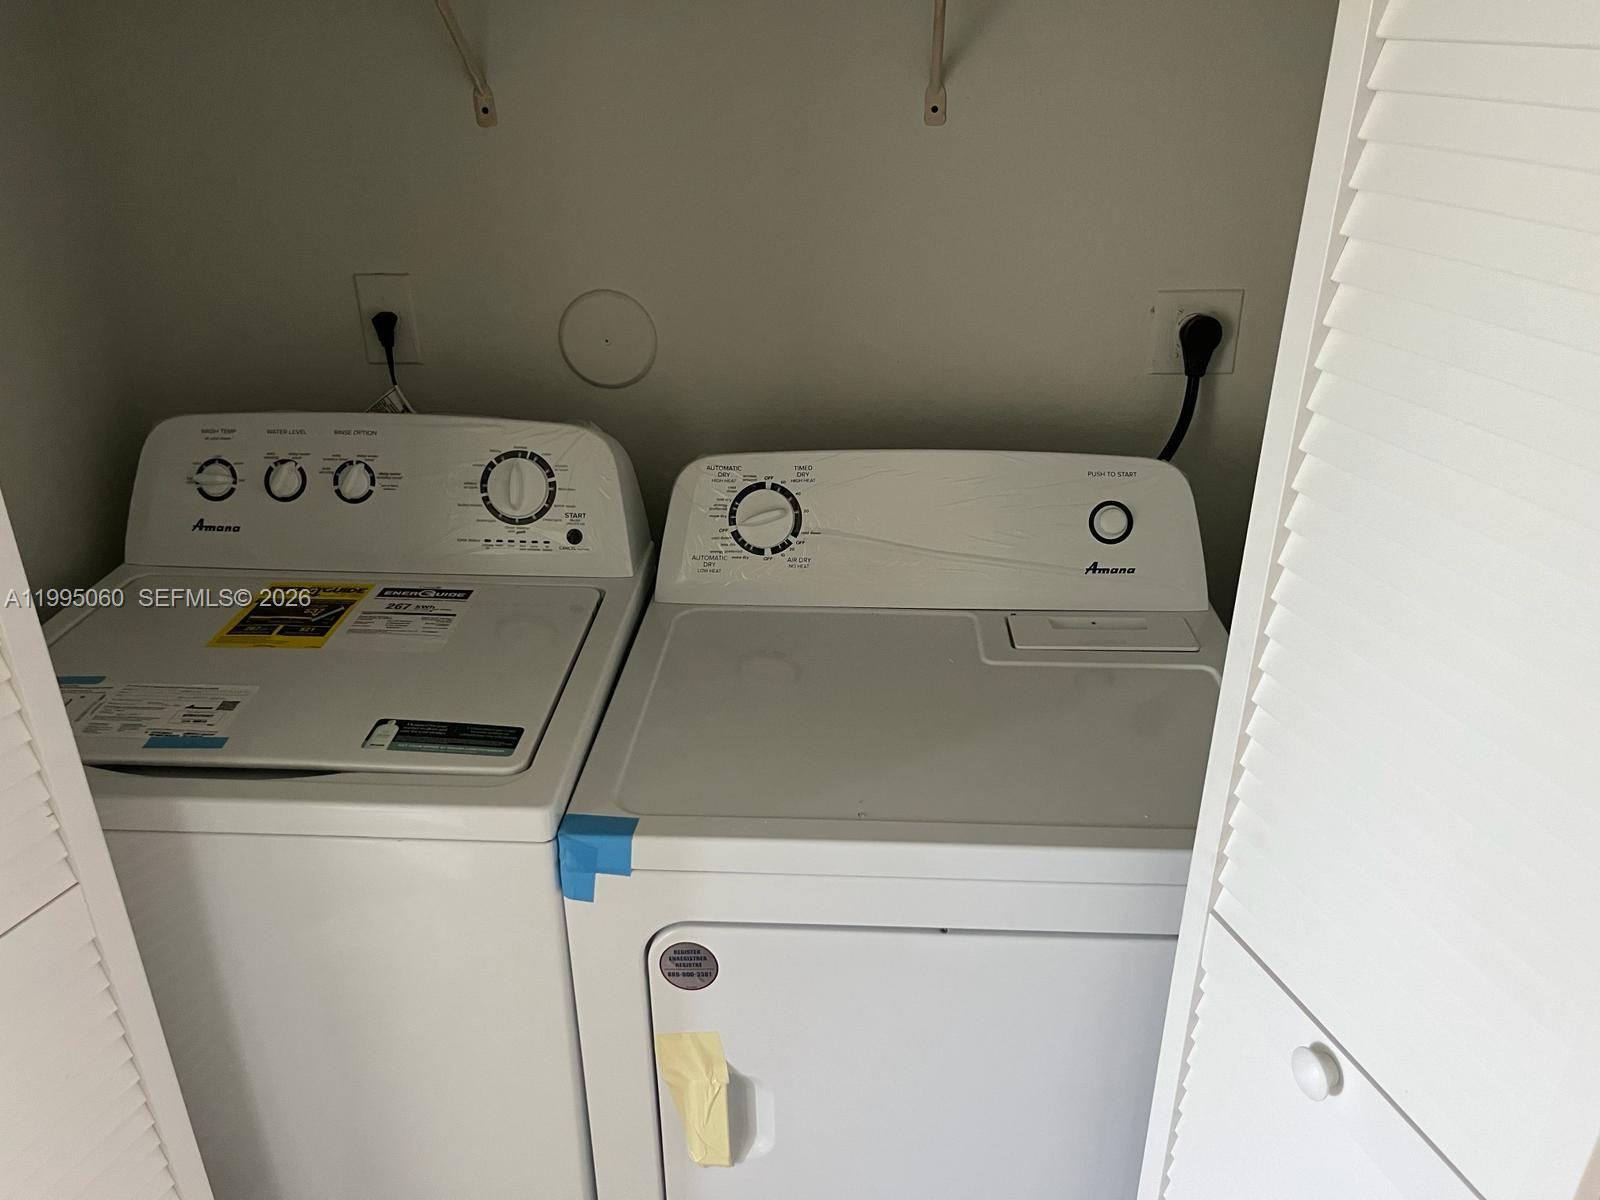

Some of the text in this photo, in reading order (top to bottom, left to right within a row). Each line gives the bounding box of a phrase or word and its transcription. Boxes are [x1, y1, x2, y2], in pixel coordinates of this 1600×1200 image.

[192, 518, 241, 532] Amana
[1084, 561, 1136, 575] Amana
[383, 589, 466, 598] ENERGUIDE
